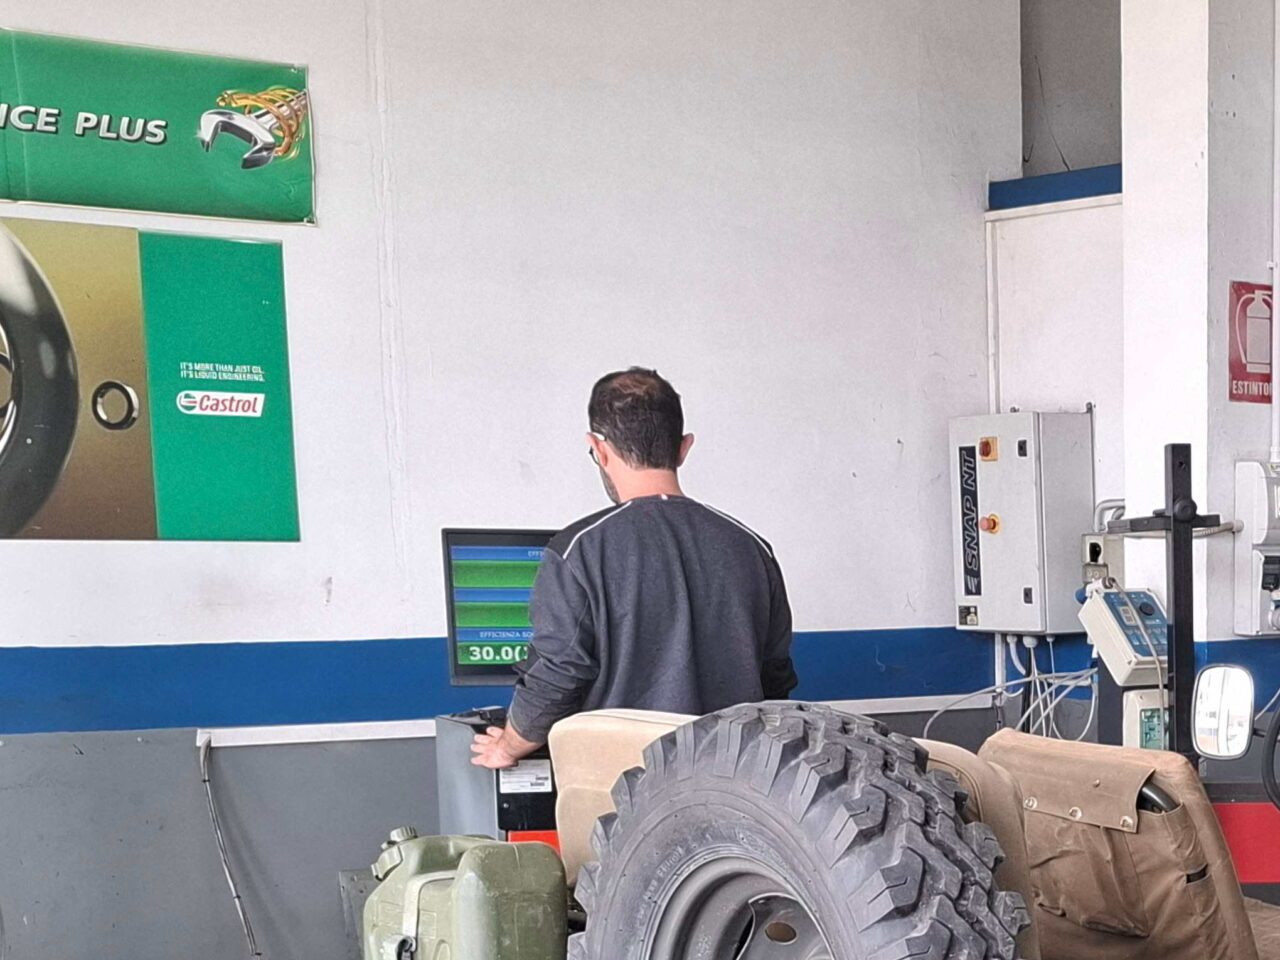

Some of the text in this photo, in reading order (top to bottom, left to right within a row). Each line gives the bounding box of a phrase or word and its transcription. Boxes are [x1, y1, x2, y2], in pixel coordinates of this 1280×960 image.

[75, 111, 168, 144] PLUS
[180, 362, 193, 370] IT'S
[194, 363, 214, 371] MORE
[215, 363, 233, 372] THAN
[235, 365, 251, 373] JUST
[180, 370, 193, 378] IT'S
[195, 371, 217, 379] LIQUID
[200, 394, 258, 413] Castrol
[962, 450, 979, 571] SNAP NT
